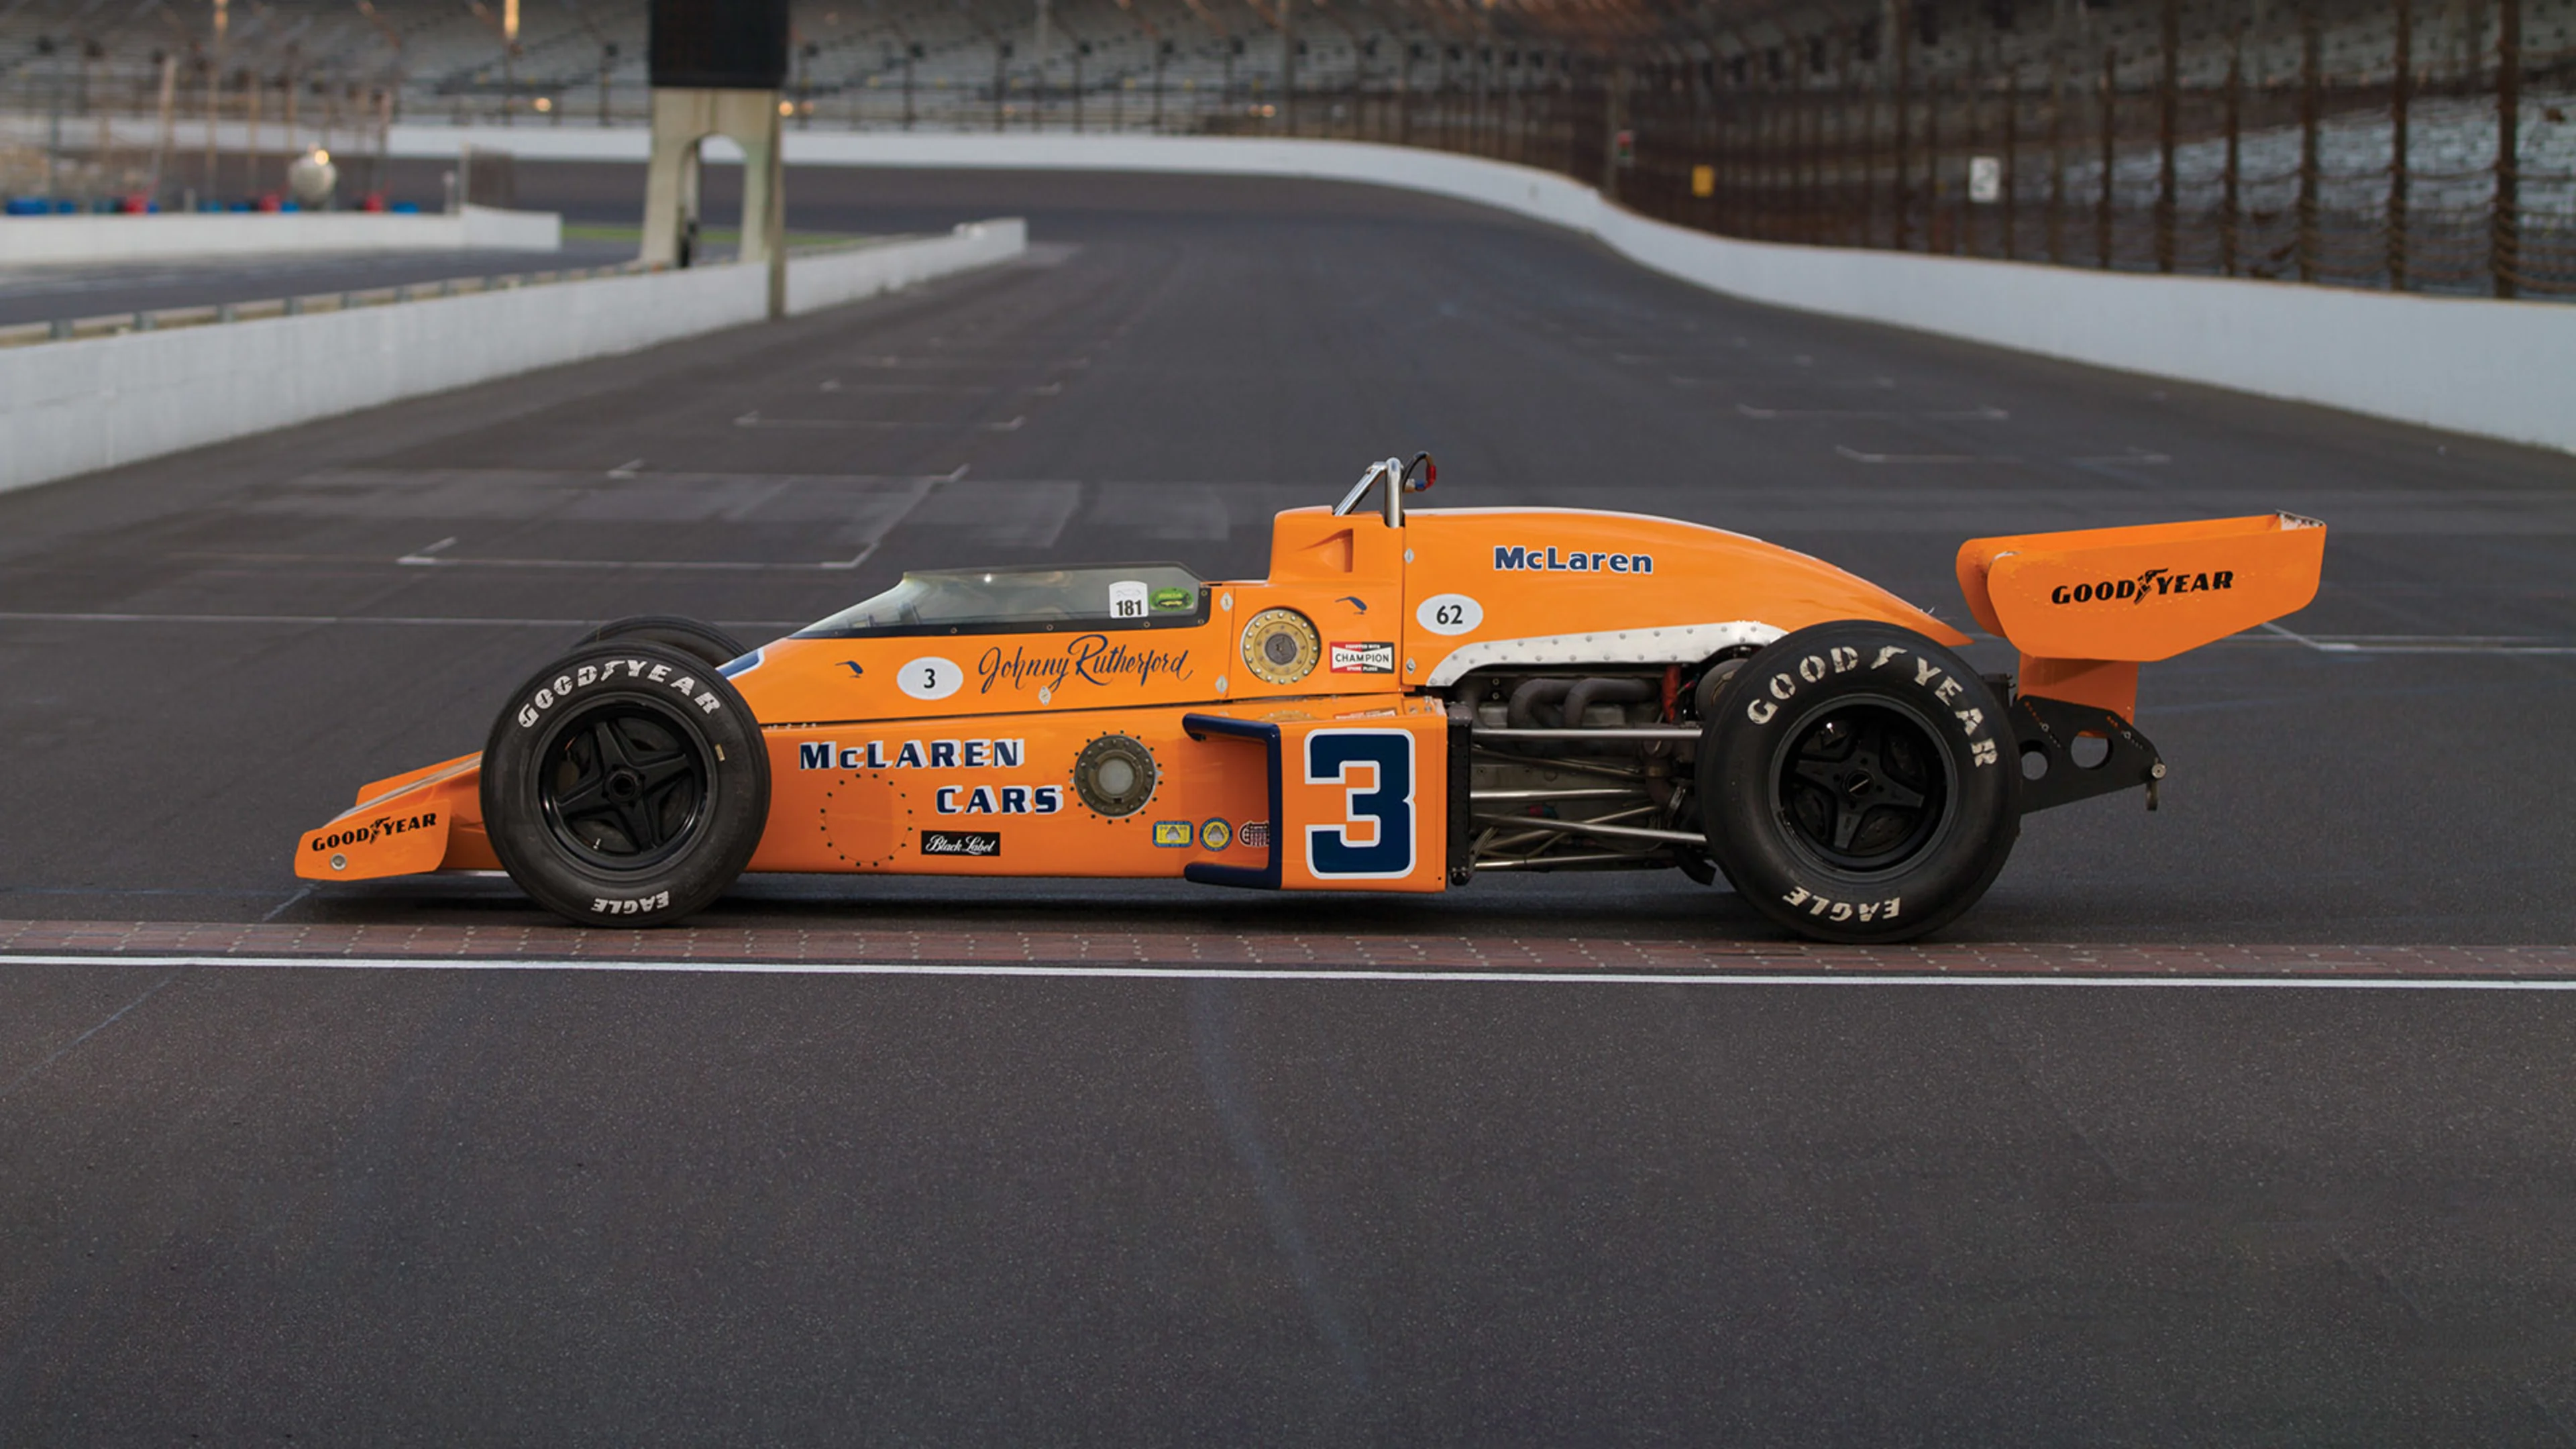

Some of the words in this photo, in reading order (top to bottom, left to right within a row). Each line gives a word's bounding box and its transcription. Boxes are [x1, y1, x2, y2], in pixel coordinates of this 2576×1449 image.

[1494, 545, 1654, 574] McLaren
[1116, 600, 1142, 616] 181
[1436, 604, 1463, 625] 62
[978, 646, 1070, 694] Johnny
[1067, 634, 1193, 686] Rutherford
[1335, 653, 1389, 662] CHAMPION
[924, 668, 936, 689] 3
[799, 739, 1024, 769] McLAREN
[936, 785, 1064, 814] CARS
[1304, 728, 1416, 879] 3
[925, 834, 962, 852] Black
[965, 835, 996, 855] Label
[591, 890, 669, 914] EAGLE
[1782, 886, 1900, 922] EAGLE
